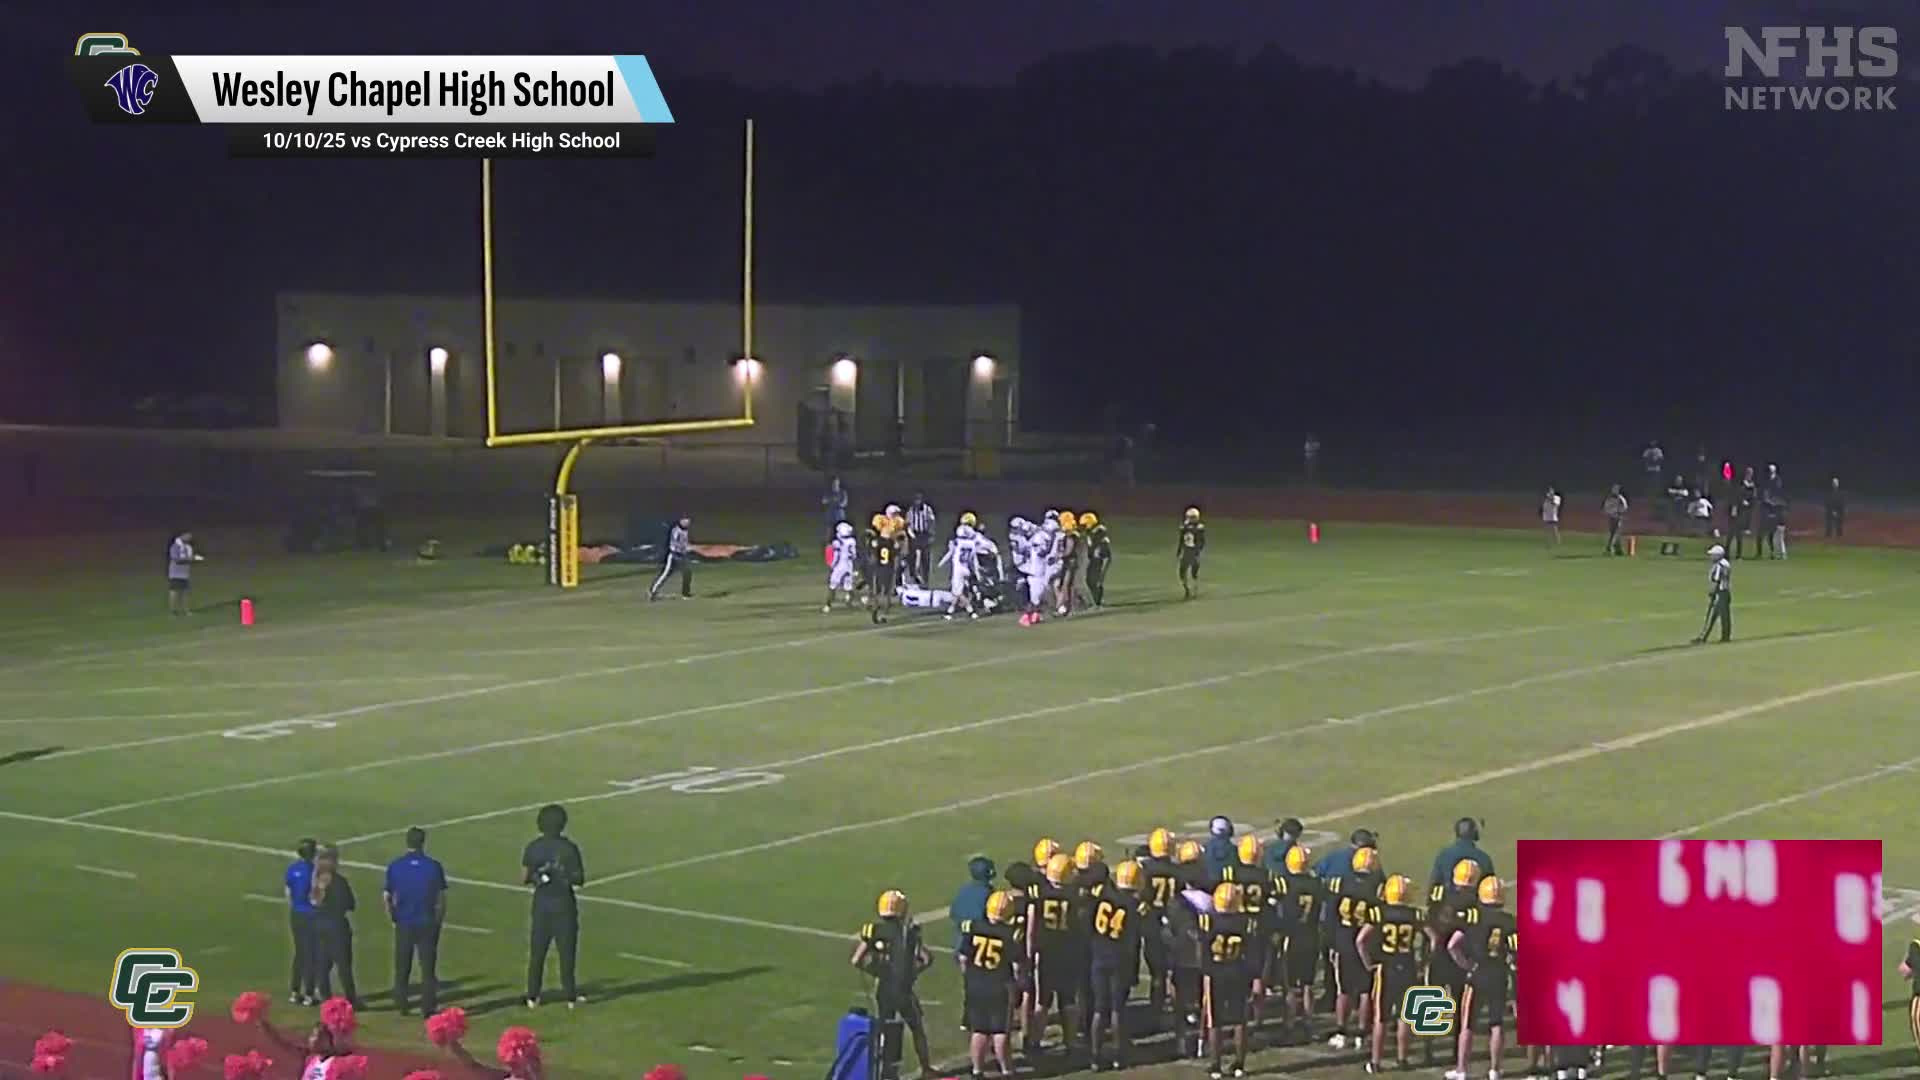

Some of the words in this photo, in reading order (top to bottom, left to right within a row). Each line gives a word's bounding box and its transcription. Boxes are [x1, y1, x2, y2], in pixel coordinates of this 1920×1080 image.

[880, 548, 889, 564] 9
[1152, 877, 1176, 907] 71
[1043, 901, 1069, 930] 51
[1095, 902, 1125, 939] 64
[972, 936, 1003, 970] 75
[1381, 923, 1413, 953] 33
